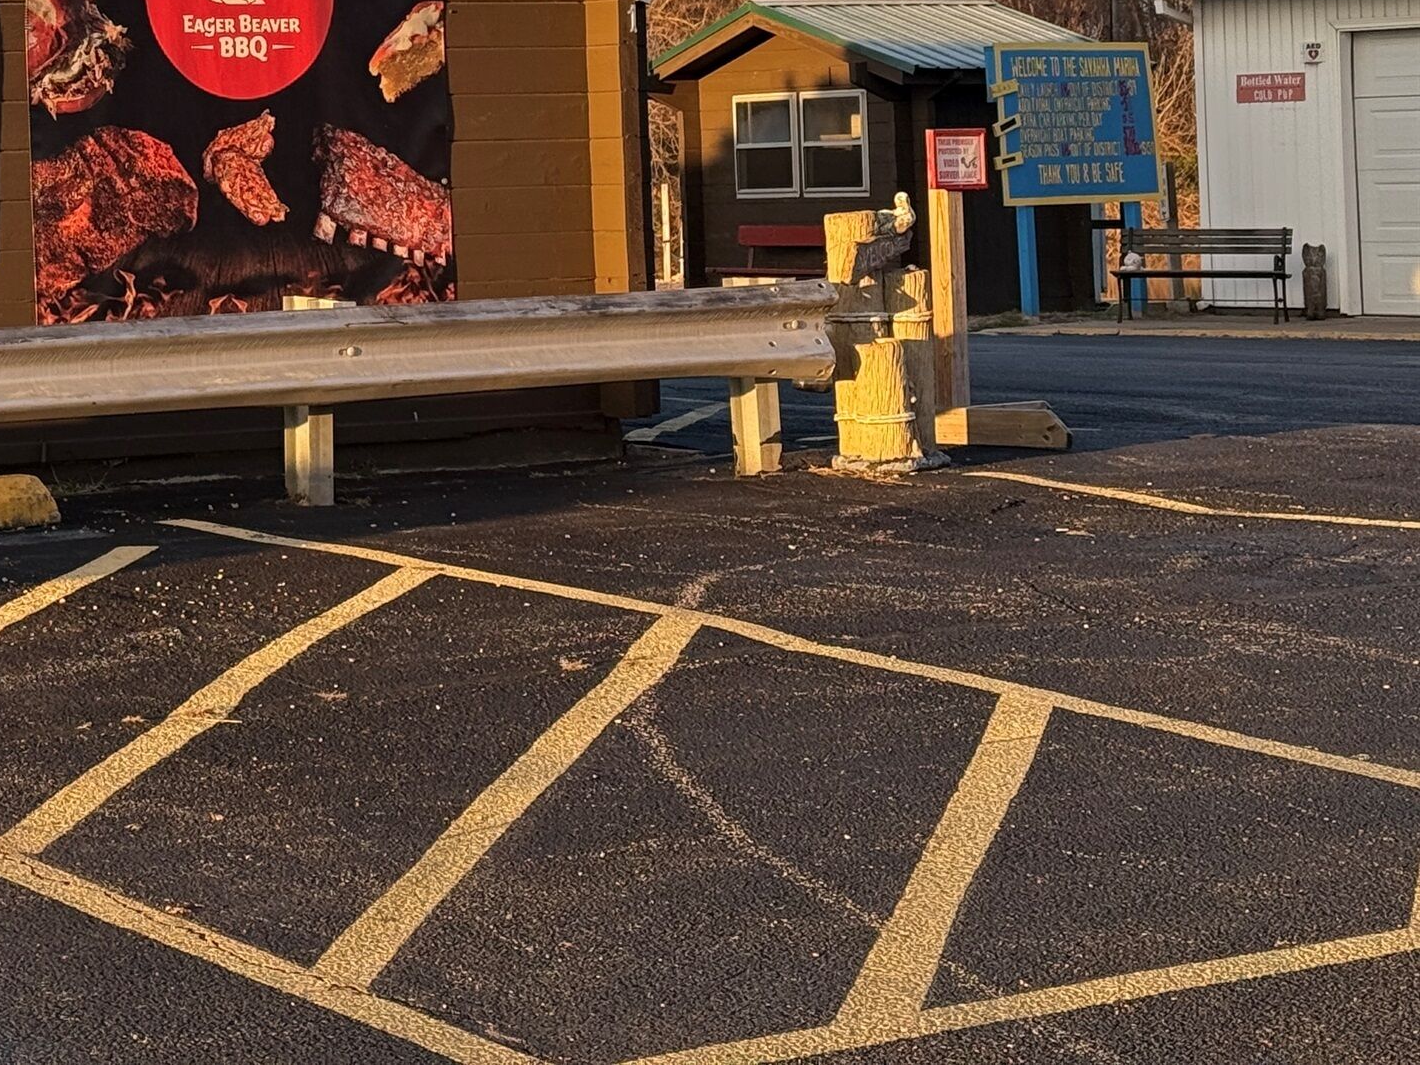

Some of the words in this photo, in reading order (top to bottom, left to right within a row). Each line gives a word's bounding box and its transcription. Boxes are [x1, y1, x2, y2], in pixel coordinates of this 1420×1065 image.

[182, 14, 236, 37] EAGER
[238, 13, 301, 33] BEAVER
[218, 35, 269, 62] BBQ
[1010, 56, 1048, 77] WELCOME
[1050, 56, 1060, 77] TO
[1062, 56, 1077, 77] THE
[1113, 56, 1140, 77] MARINA
[1240, 75, 1272, 87] Bottled
[1273, 74, 1301, 86] Water
[1253, 90, 1273, 101] COLD
[1044, 143, 1060, 157] PASS
[1093, 141, 1120, 156] DISTRICT
[1037, 164, 1063, 185] THANK
[1065, 163, 1080, 184] YOU
[1083, 163, 1090, 183] &
[1091, 162, 1103, 183] BE
[1105, 162, 1125, 183] SAFE
